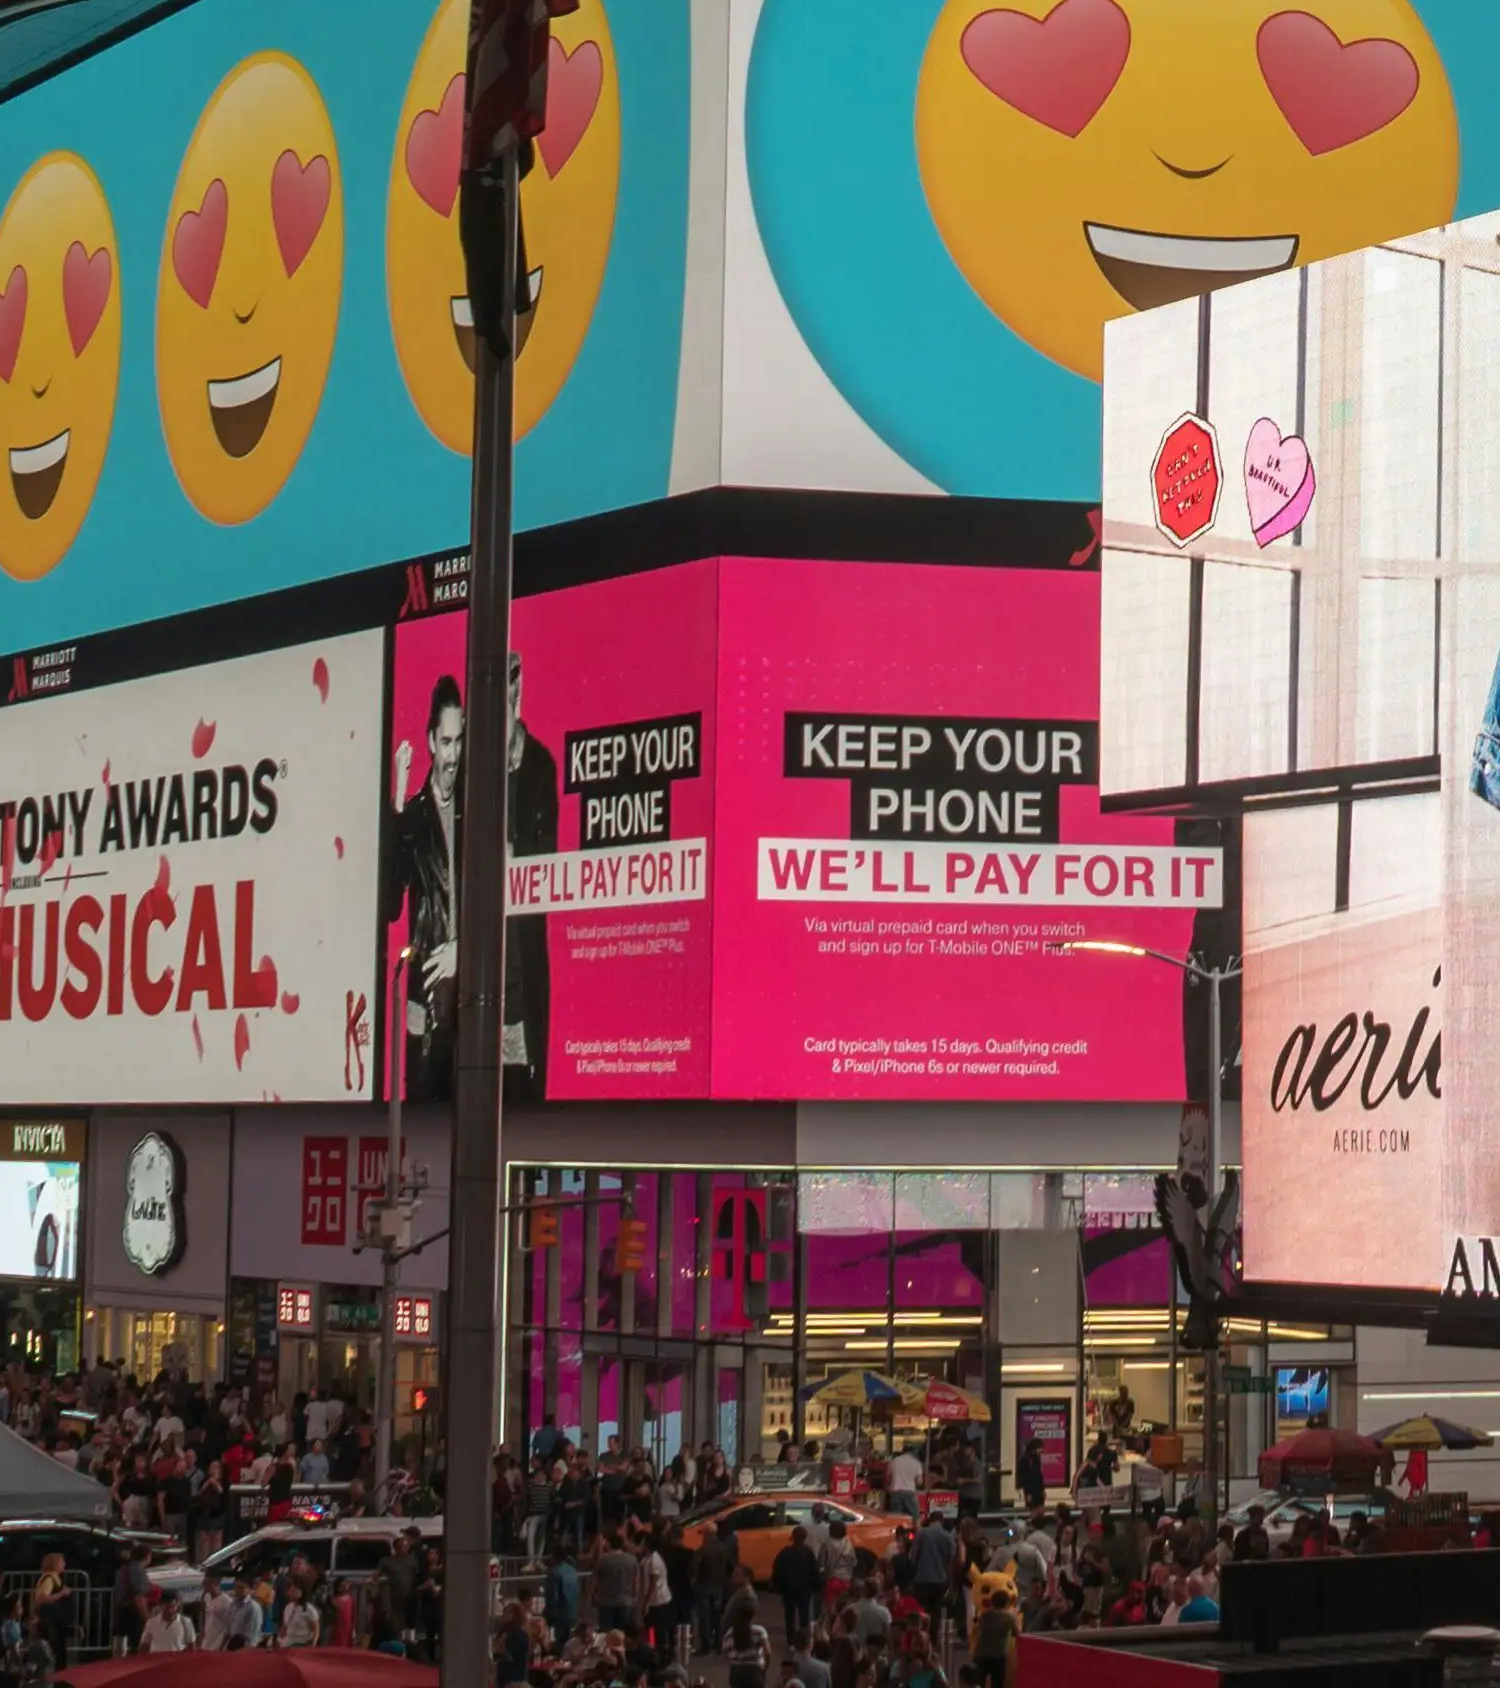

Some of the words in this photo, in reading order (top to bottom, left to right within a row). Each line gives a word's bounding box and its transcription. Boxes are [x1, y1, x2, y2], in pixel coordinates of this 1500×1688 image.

[433, 556, 471, 578] MARRI
[433, 580, 468, 603] MARQ
[32, 647, 77, 669] MARRIOTT
[31, 669, 72, 690] MARQUIS
[570, 738, 628, 783] KEEP
[634, 725, 695, 772] YOUR
[802, 723, 931, 770] KEEP
[944, 728, 1082, 775] YOUR
[586, 790, 665, 840] PHONE
[869, 787, 1042, 835] PHONE
[509, 862, 575, 906] WE'LL
[580, 856, 622, 899] PAY
[628, 851, 673, 895] FOR
[680, 849, 702, 891] IT
[768, 847, 930, 893] WE'LL
[946, 852, 1041, 895] PAY
[1055, 854, 1154, 898] FOR
[1170, 857, 1215, 899] IT
[804, 917, 828, 933] Via
[831, 918, 874, 934] virtual
[878, 919, 933, 936] prepaid
[936, 920, 968, 935] card
[971, 921, 1009, 935] when
[1012, 924, 1038, 939] you
[1041, 921, 1086, 937] switch
[818, 939, 846, 953] and
[849, 939, 879, 955] sign
[884, 942, 901, 957] up
[905, 939, 924, 954] for
[928, 940, 988, 955] T-Mobile
[804, 1037, 836, 1053] Card
[839, 1038, 890, 1056] typically
[894, 1038, 927, 1053] takes
[931, 1039, 947, 1053] 15
[950, 1039, 982, 1055] days.
[986, 1039, 1049, 1056] Qualifying
[1052, 1040, 1088, 1054] credit
[844, 1059, 925, 1075] Pixel/iPhone
[928, 1060, 944, 1073] 6s
[947, 1062, 959, 1073] or
[962, 1062, 1002, 1074] newer
[1004, 1061, 1060, 1075] required.
[13, 1124, 65, 1152] INVICTA
[1333, 1128, 1411, 1153] AERIE.COM
